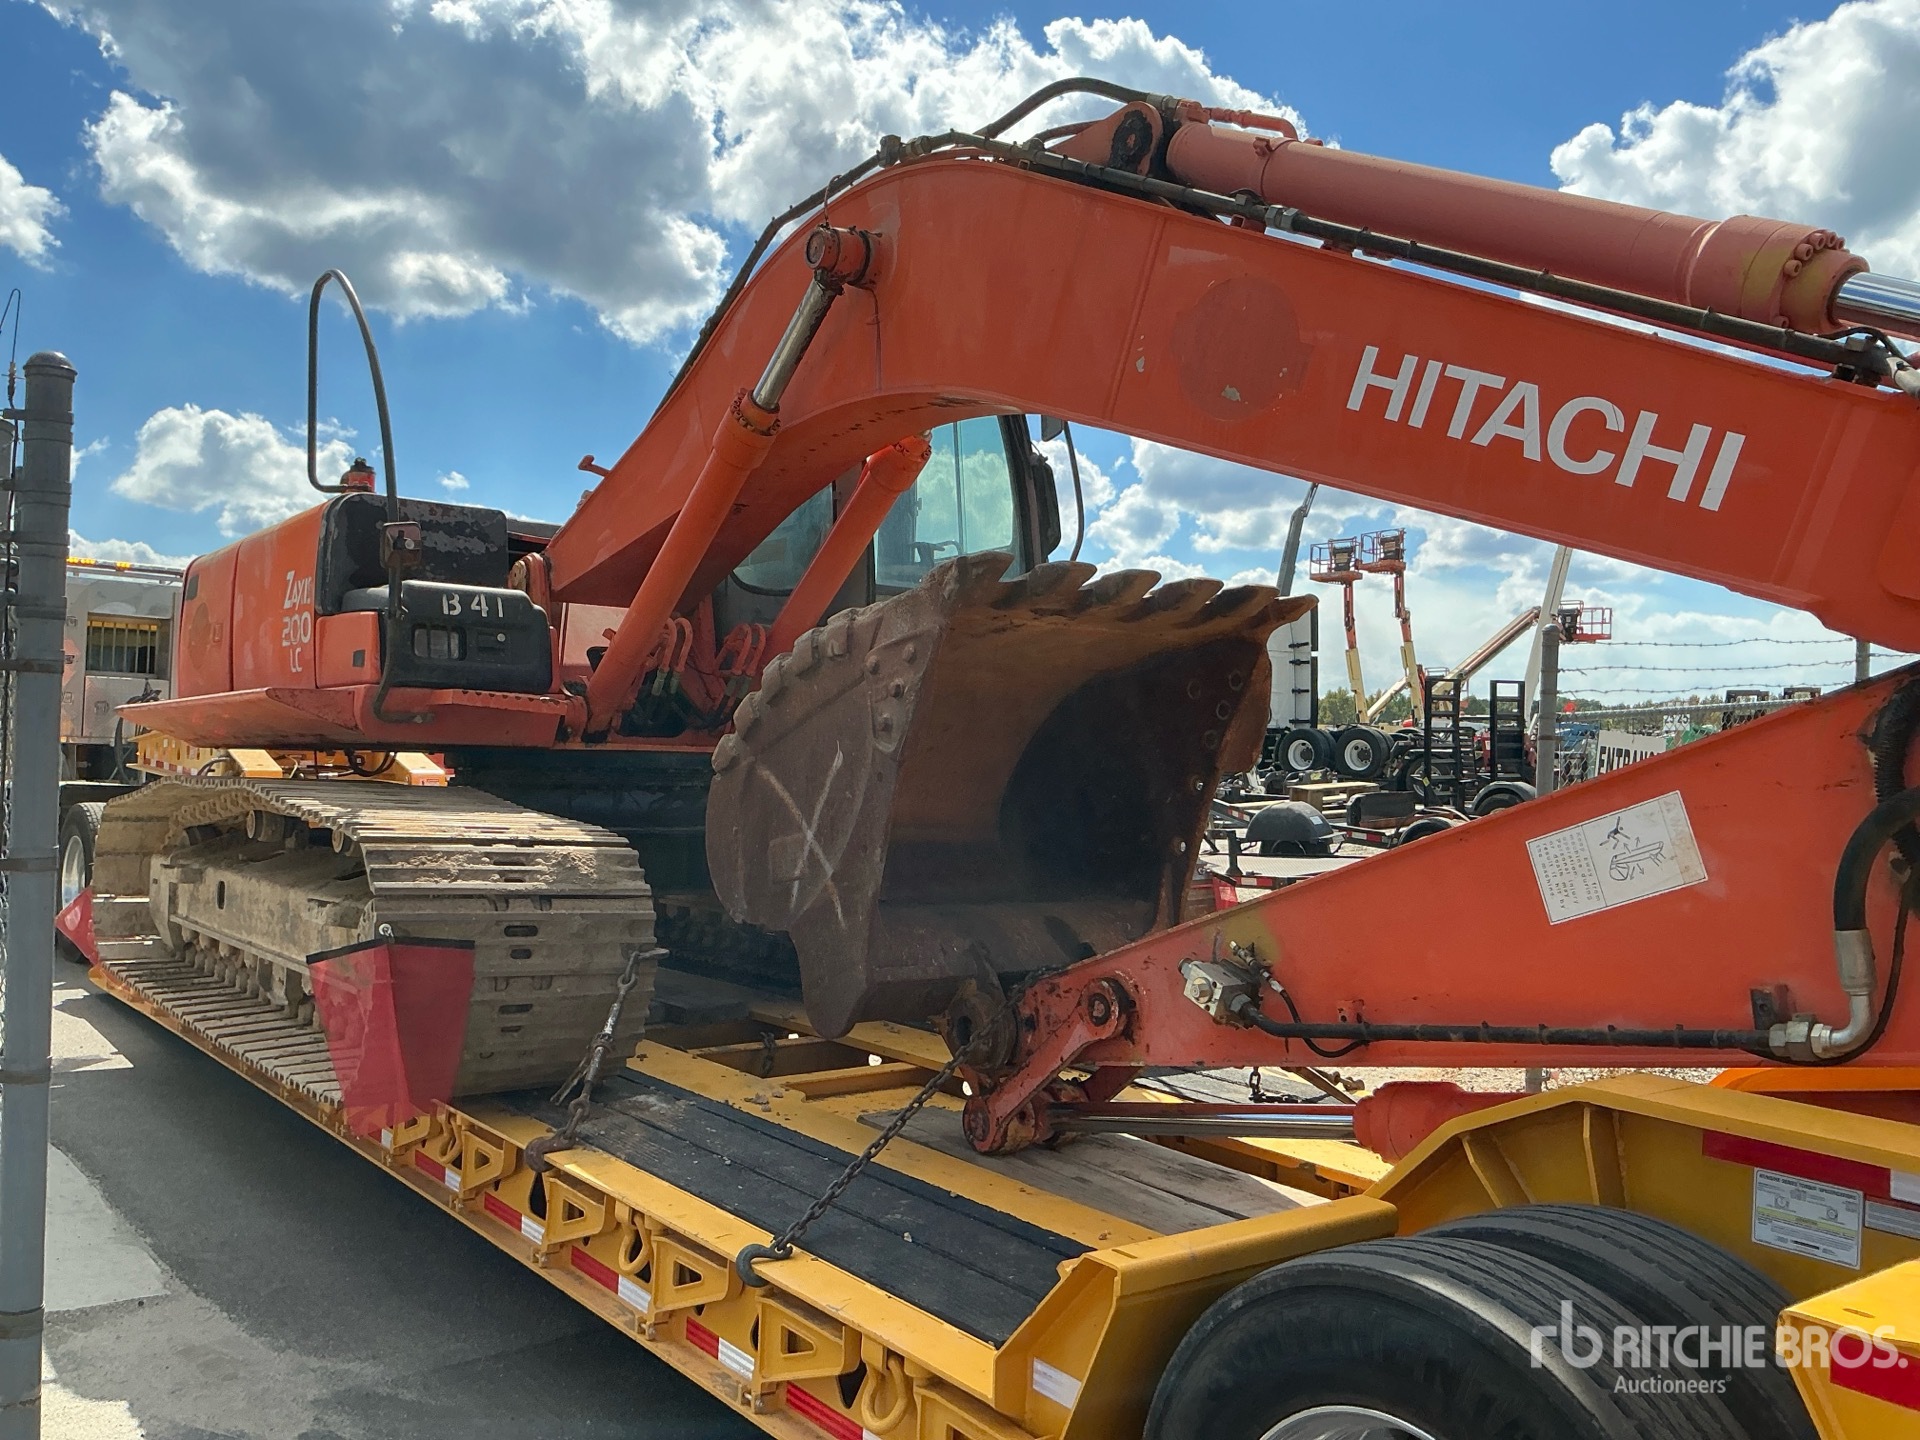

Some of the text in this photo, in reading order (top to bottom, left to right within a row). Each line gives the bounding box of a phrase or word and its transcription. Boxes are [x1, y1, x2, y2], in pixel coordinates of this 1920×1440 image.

[1346, 345, 1746, 511] HITACHI
[282, 611, 312, 647] 200
[290, 646, 303, 673] LC
[1598, 746, 1661, 774] ENTR
